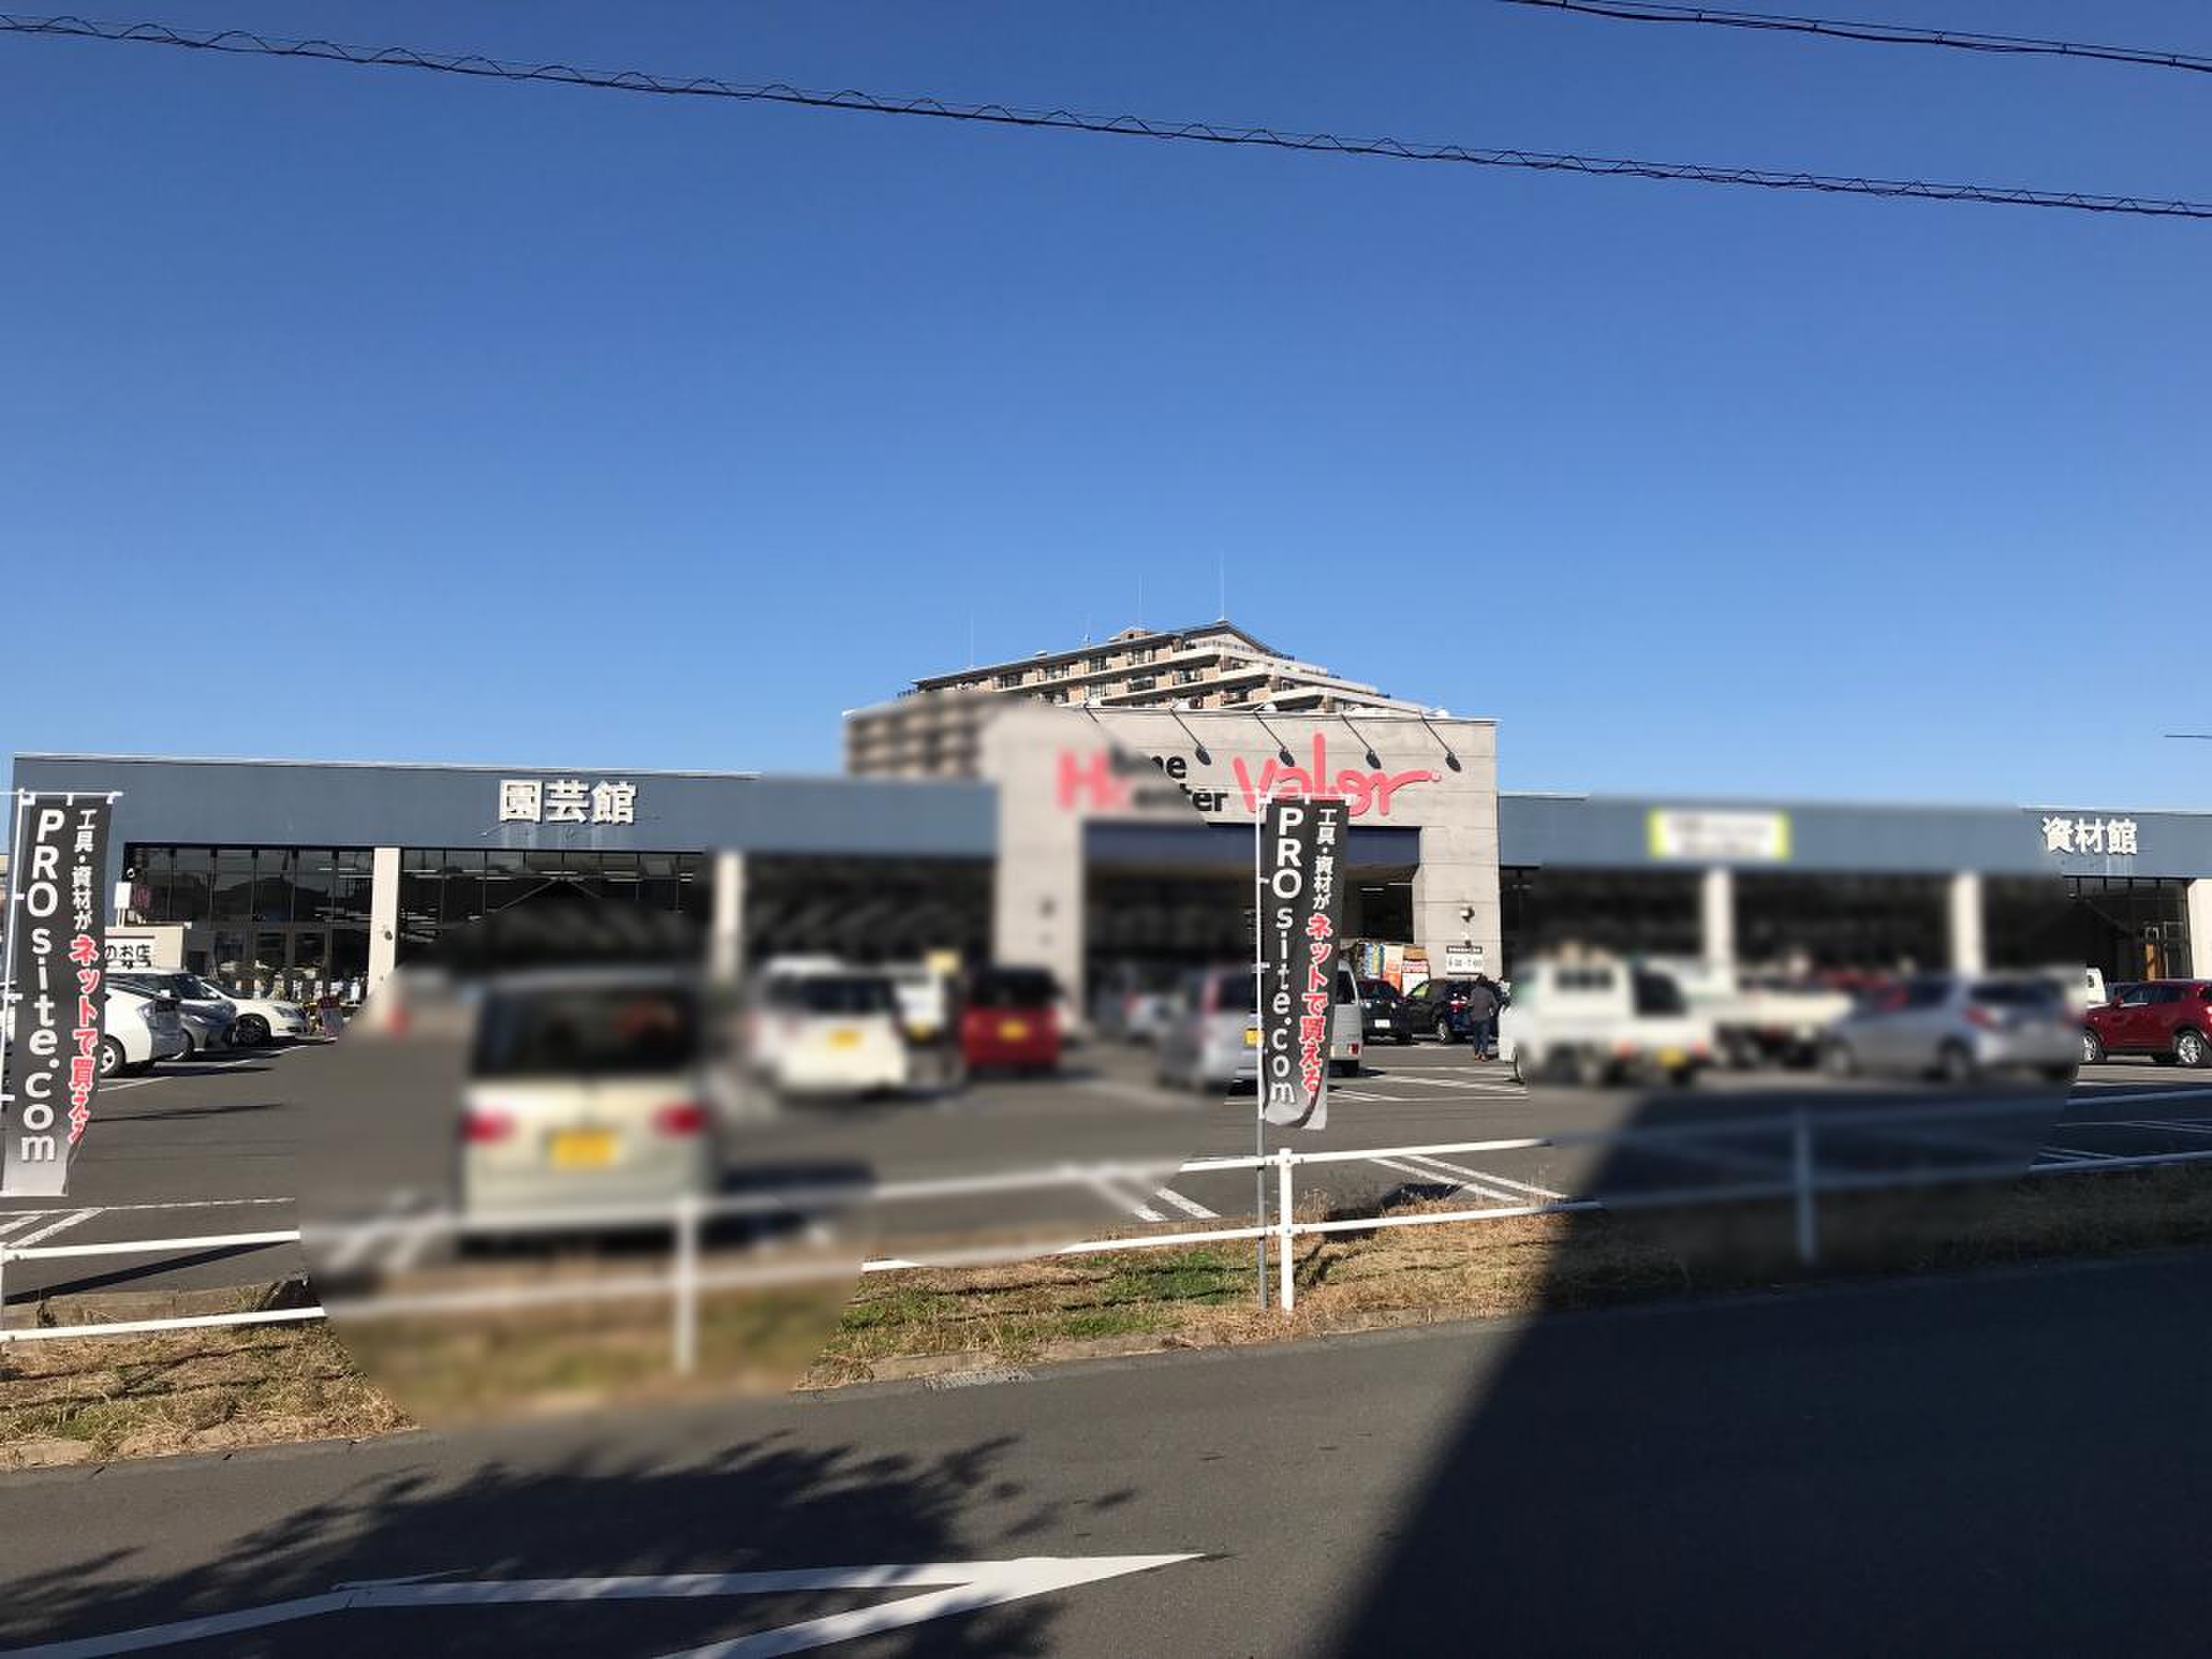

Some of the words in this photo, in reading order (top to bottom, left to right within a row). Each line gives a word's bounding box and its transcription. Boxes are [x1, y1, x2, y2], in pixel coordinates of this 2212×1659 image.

[500, 779, 637, 824] 園芸館
[2041, 816, 2138, 855] 資材館
[28, 809, 65, 917] PRO
[1272, 807, 1303, 900] PRO
